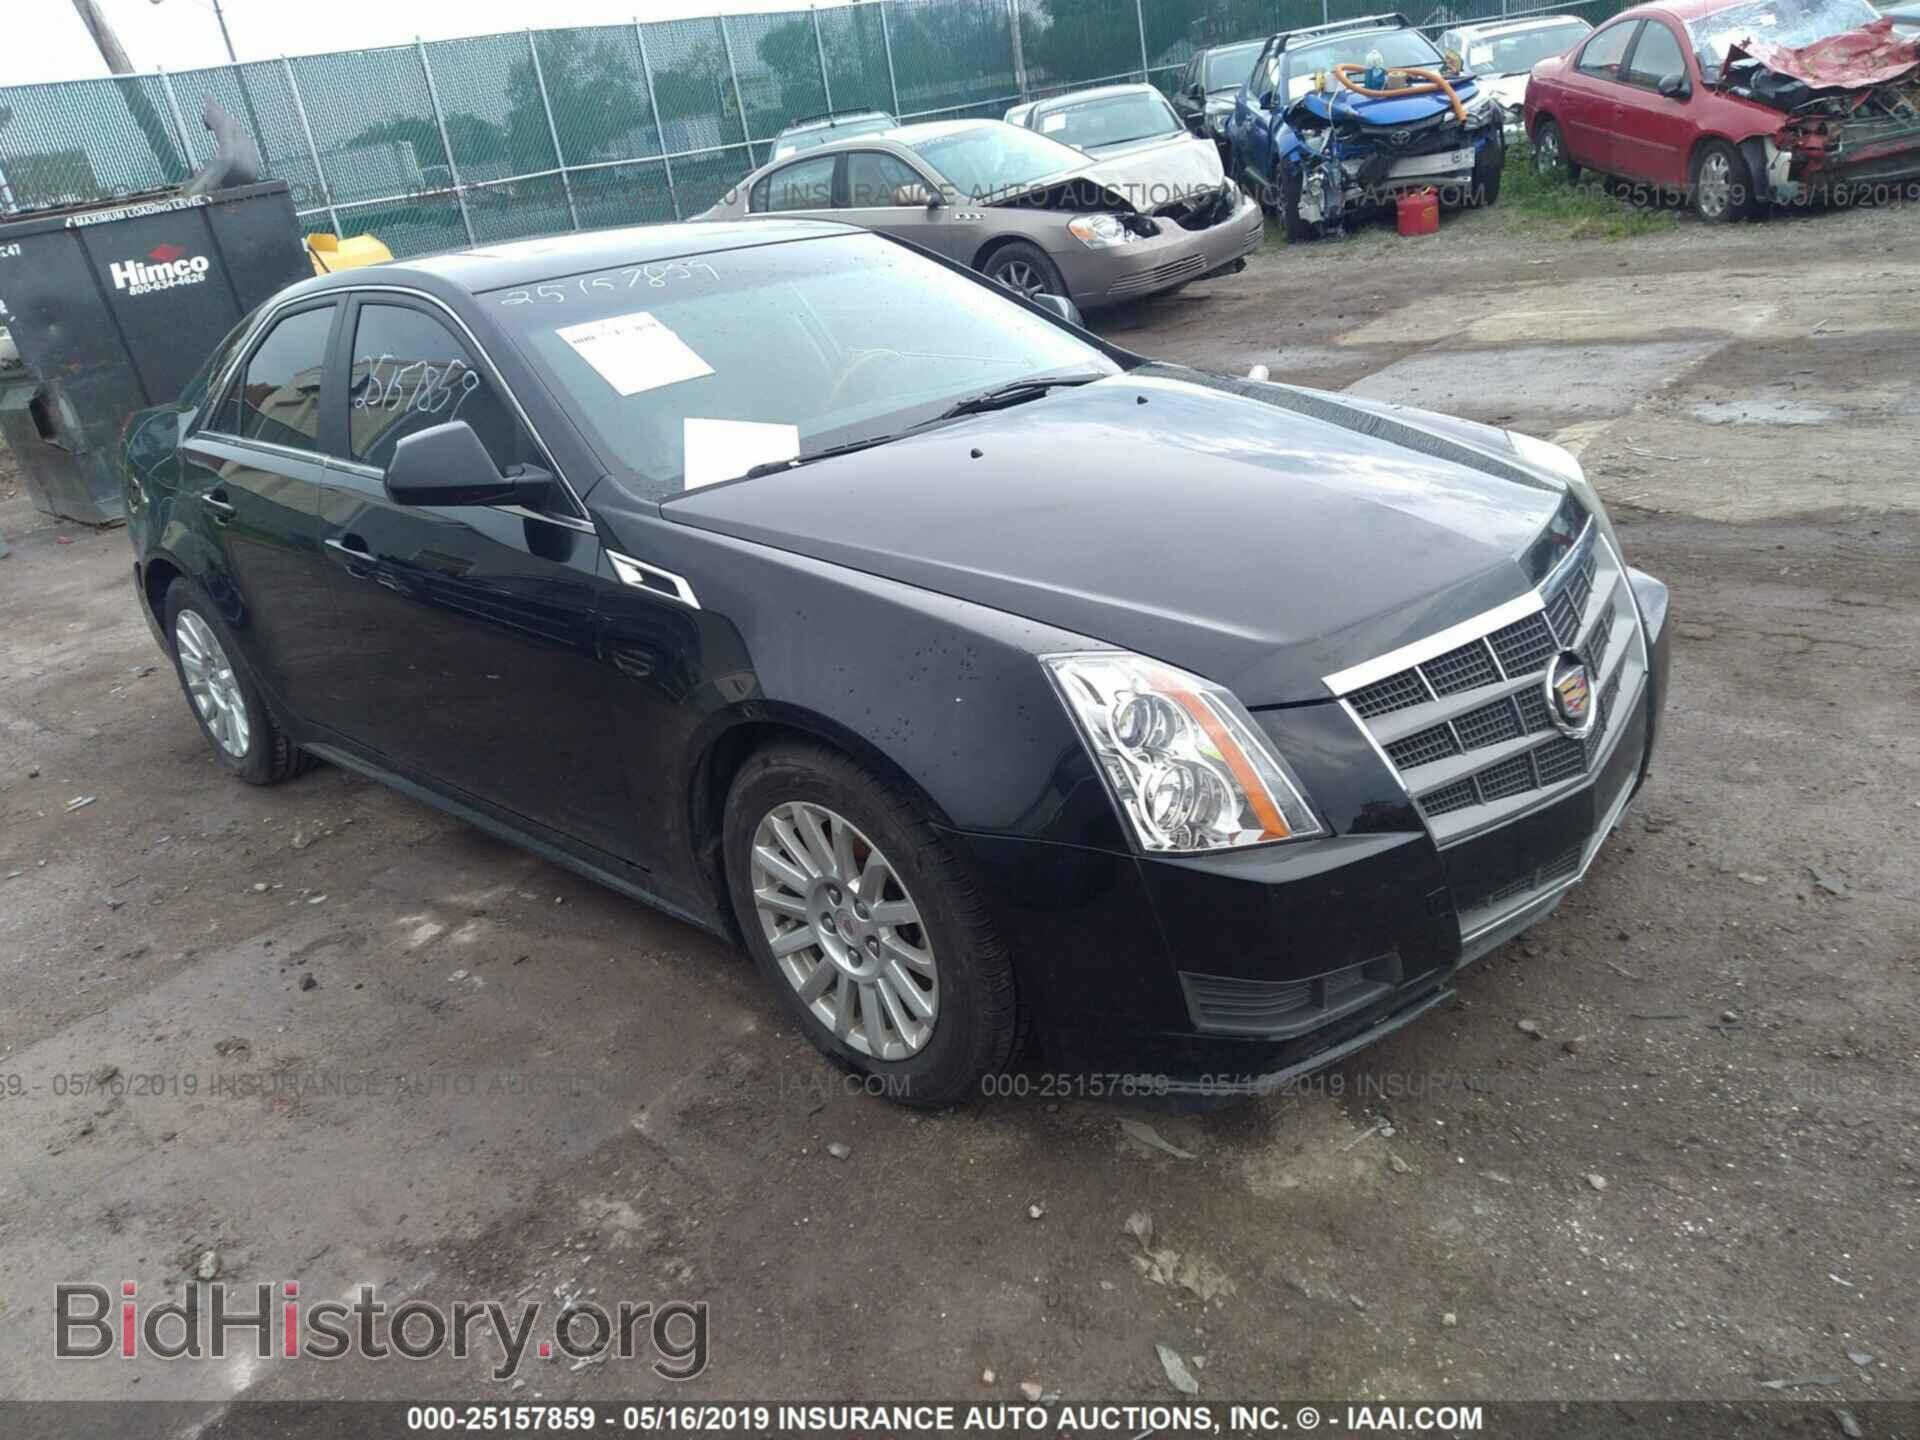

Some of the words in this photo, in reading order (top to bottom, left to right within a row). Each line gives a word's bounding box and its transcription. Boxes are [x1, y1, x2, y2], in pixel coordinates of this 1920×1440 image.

[74, 210, 127, 228] MAXIMUM
[127, 201, 172, 218] LOADING
[172, 194, 206, 210] LEVEL
[109, 255, 209, 290] Himco
[354, 353, 480, 423] 25157859
